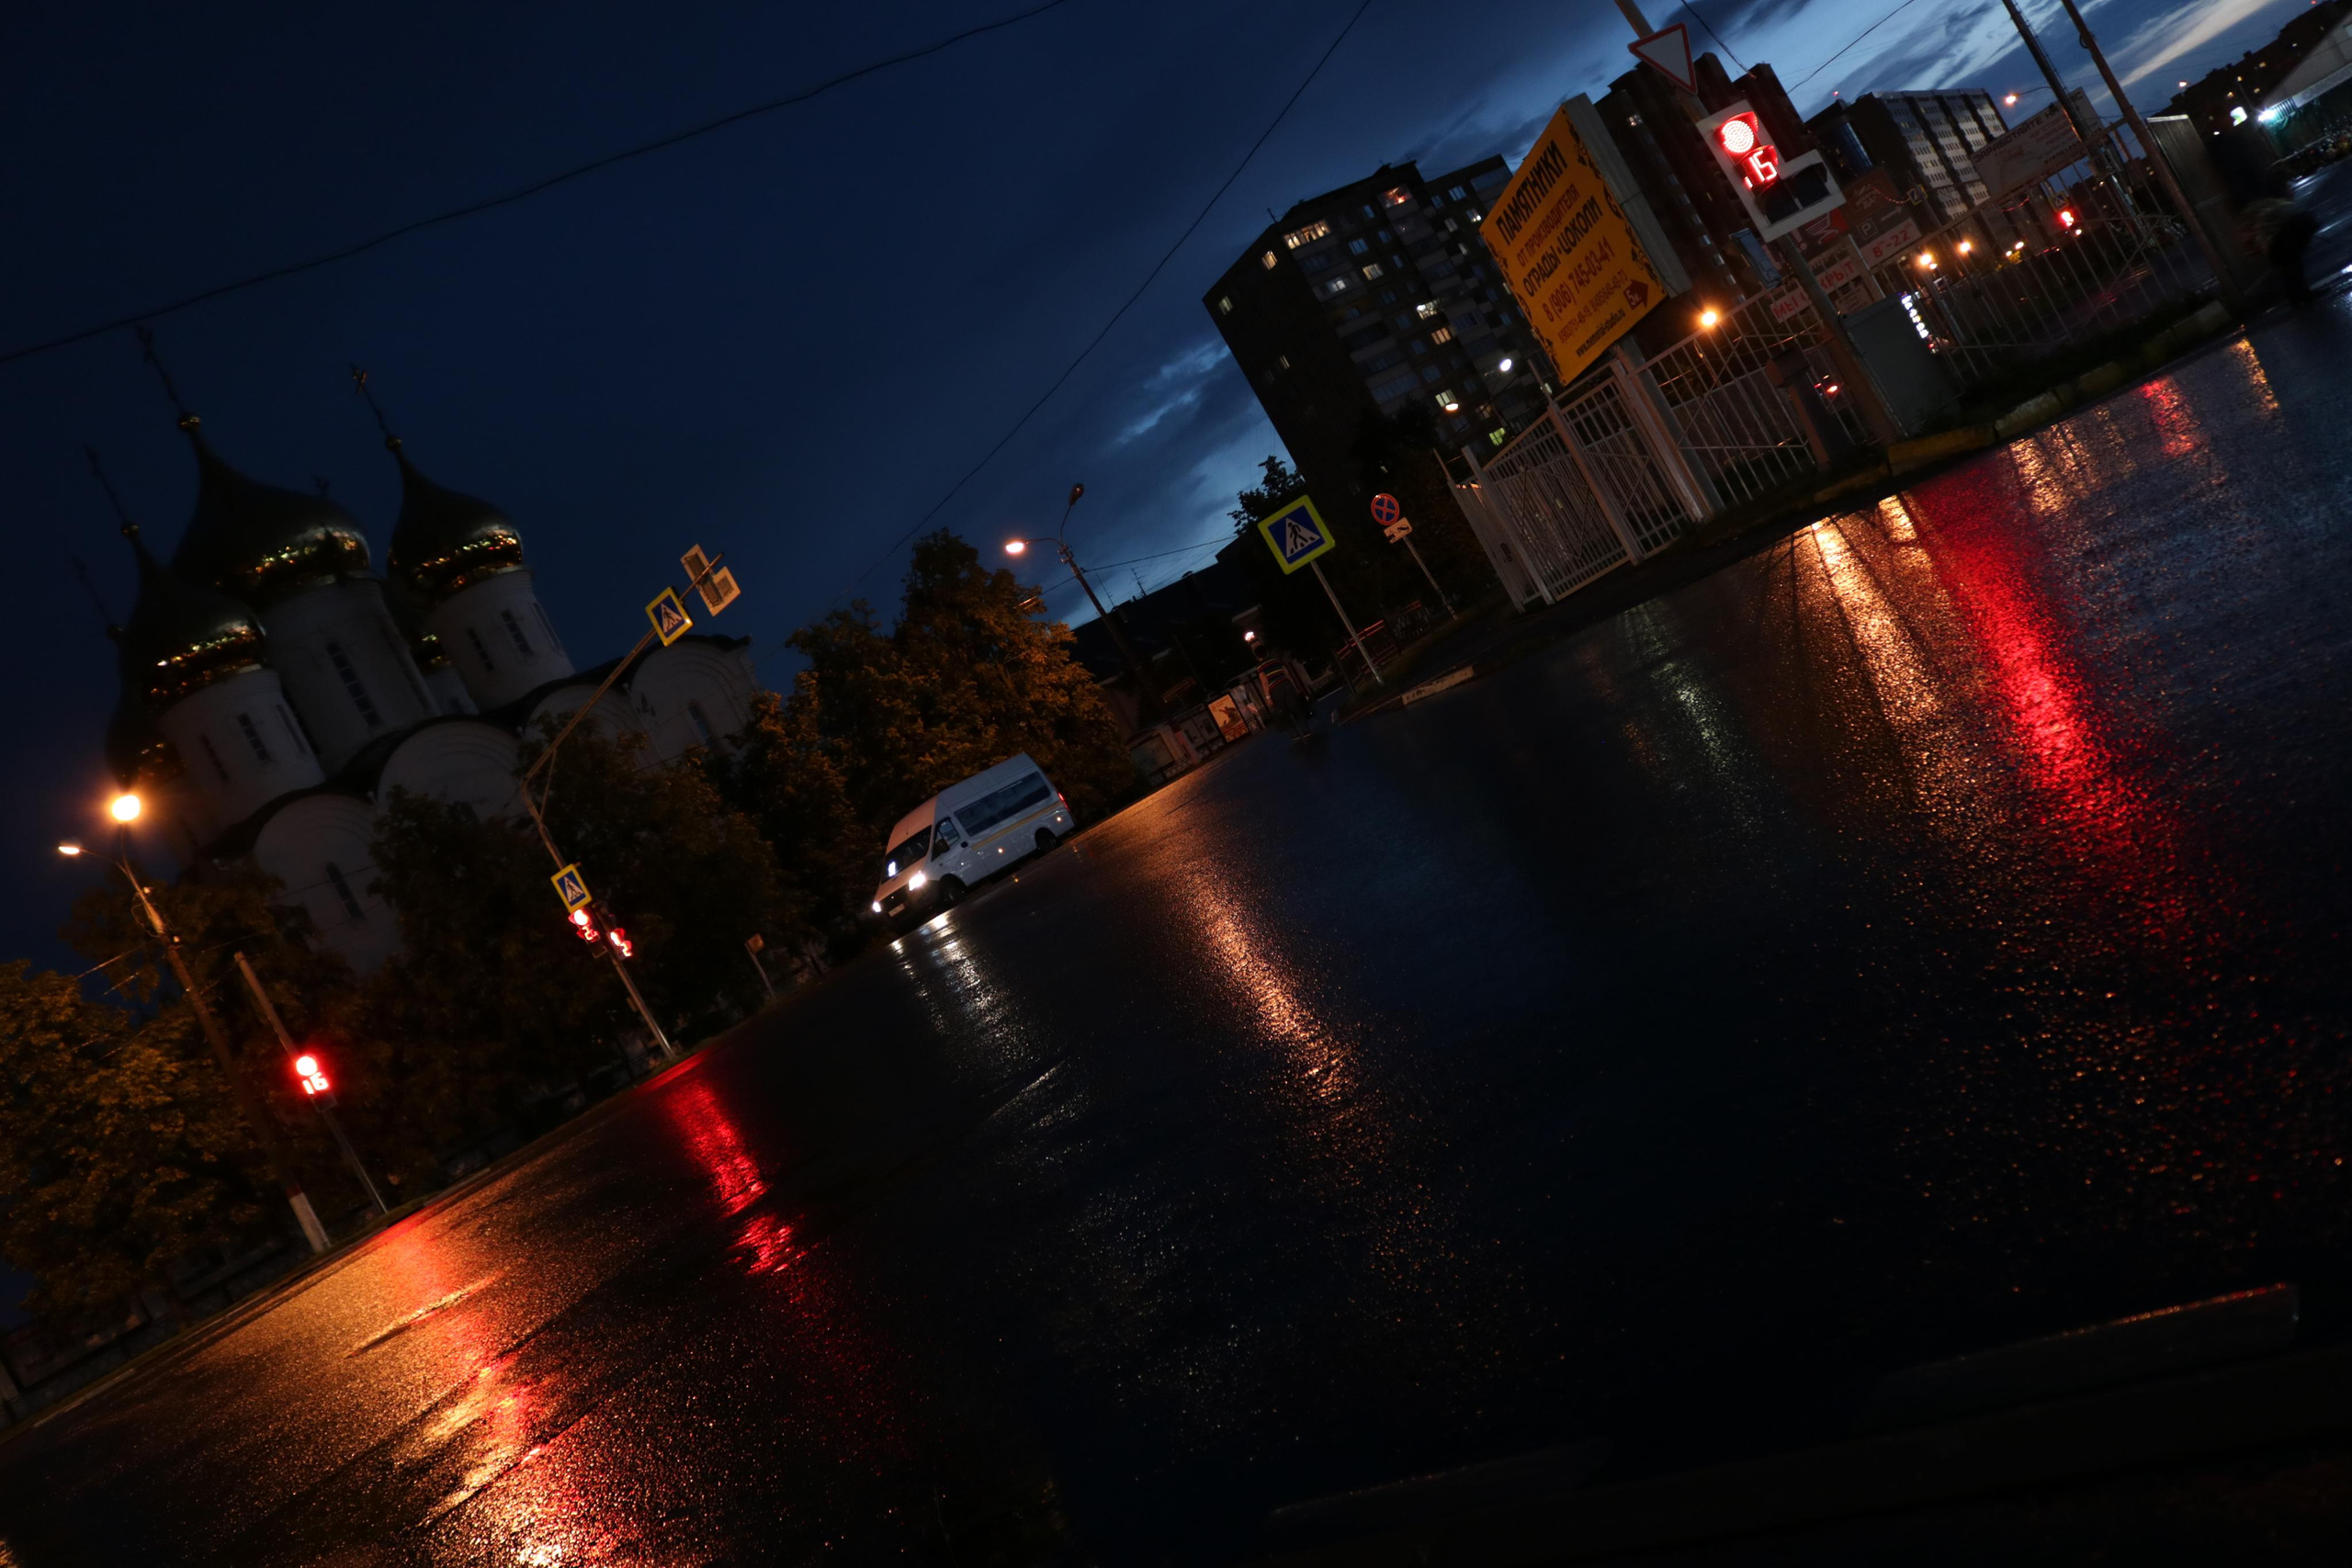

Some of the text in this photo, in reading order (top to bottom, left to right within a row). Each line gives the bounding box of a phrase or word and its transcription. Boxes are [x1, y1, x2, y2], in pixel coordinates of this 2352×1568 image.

[1973, 118, 2042, 163] ЗАРАБОТАЙТЕ
[1495, 138, 1567, 246] ПАМЯТНИКИ
[1516, 181, 1581, 267] ОТ ПРОИЗВОДИТЕЛЯ
[1521, 194, 1603, 299] ОГРАДЫ ЦОКОЛИ
[1541, 234, 1615, 323] 8 (906) 745-03-41
